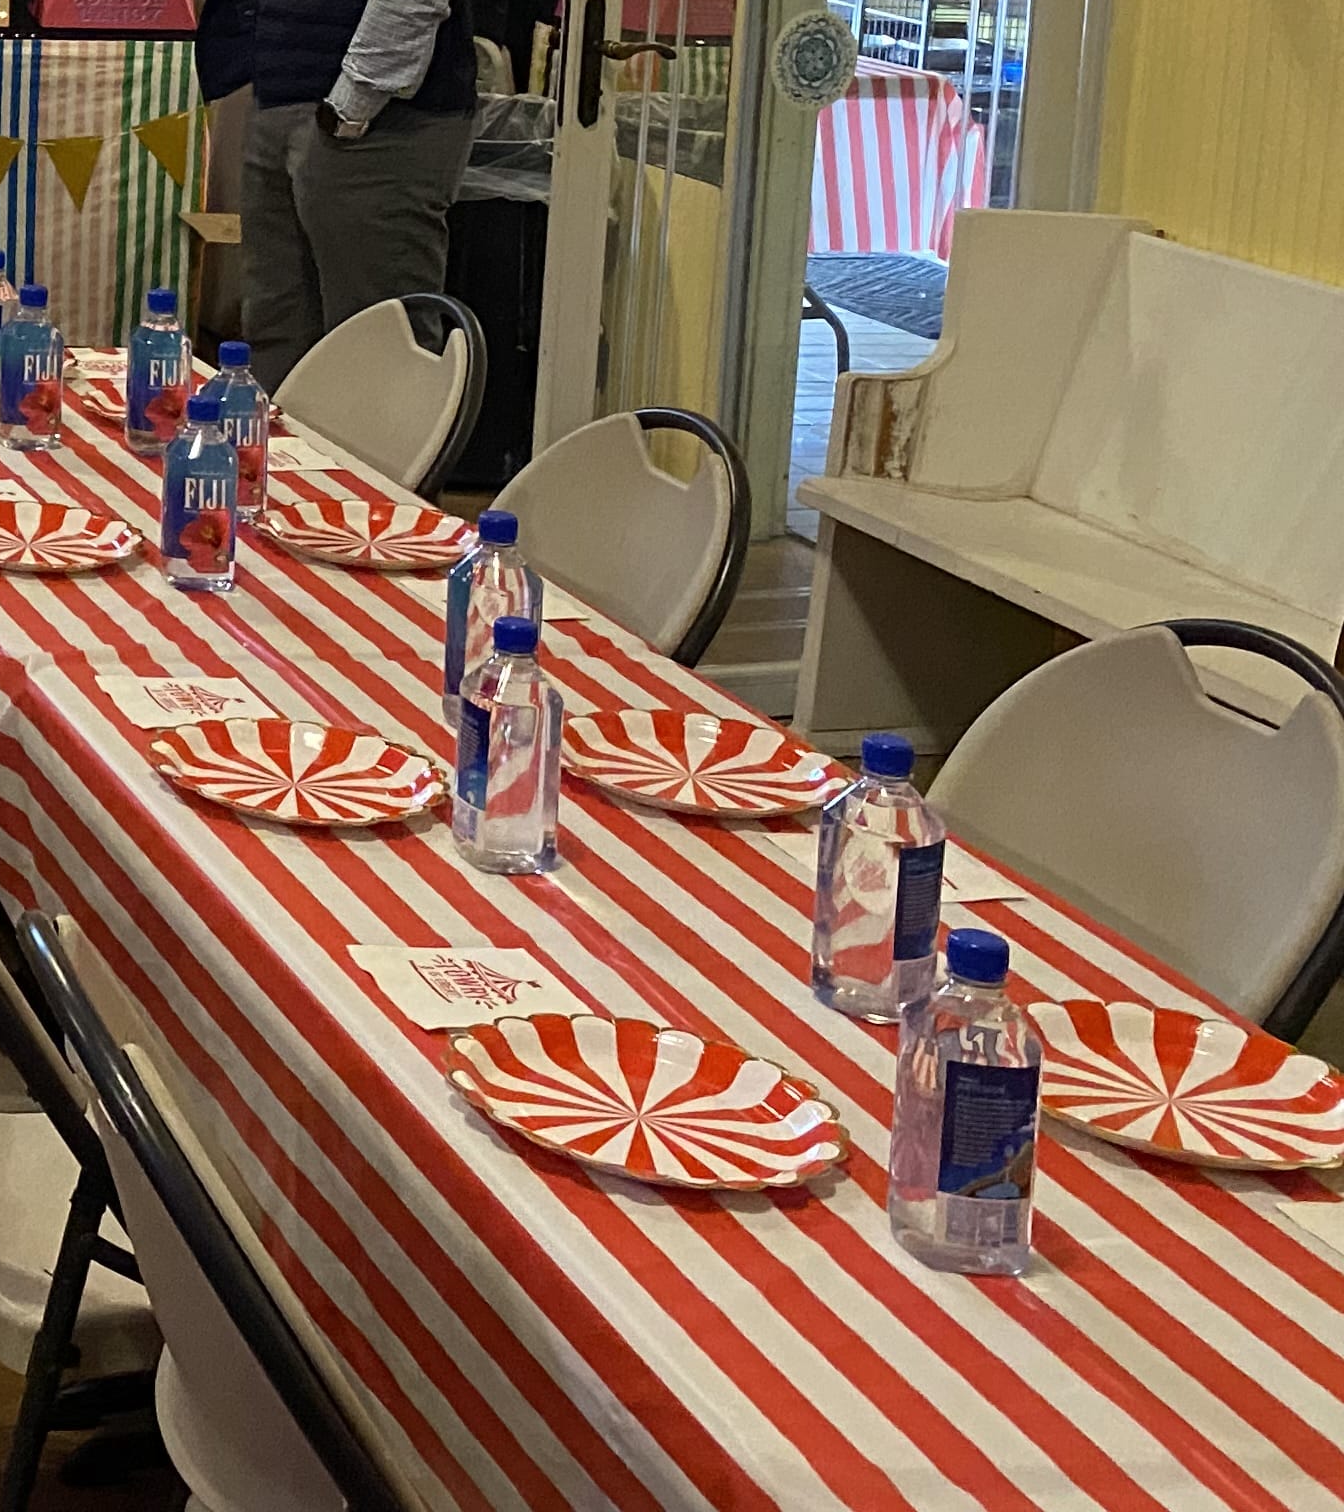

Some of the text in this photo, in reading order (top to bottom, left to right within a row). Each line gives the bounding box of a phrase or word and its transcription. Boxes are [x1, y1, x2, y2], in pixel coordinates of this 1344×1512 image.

[24, 354, 58, 381] FIJI
[150, 359, 186, 386] FIJI
[223, 418, 261, 446] FIJI
[184, 477, 226, 509] FIJI
